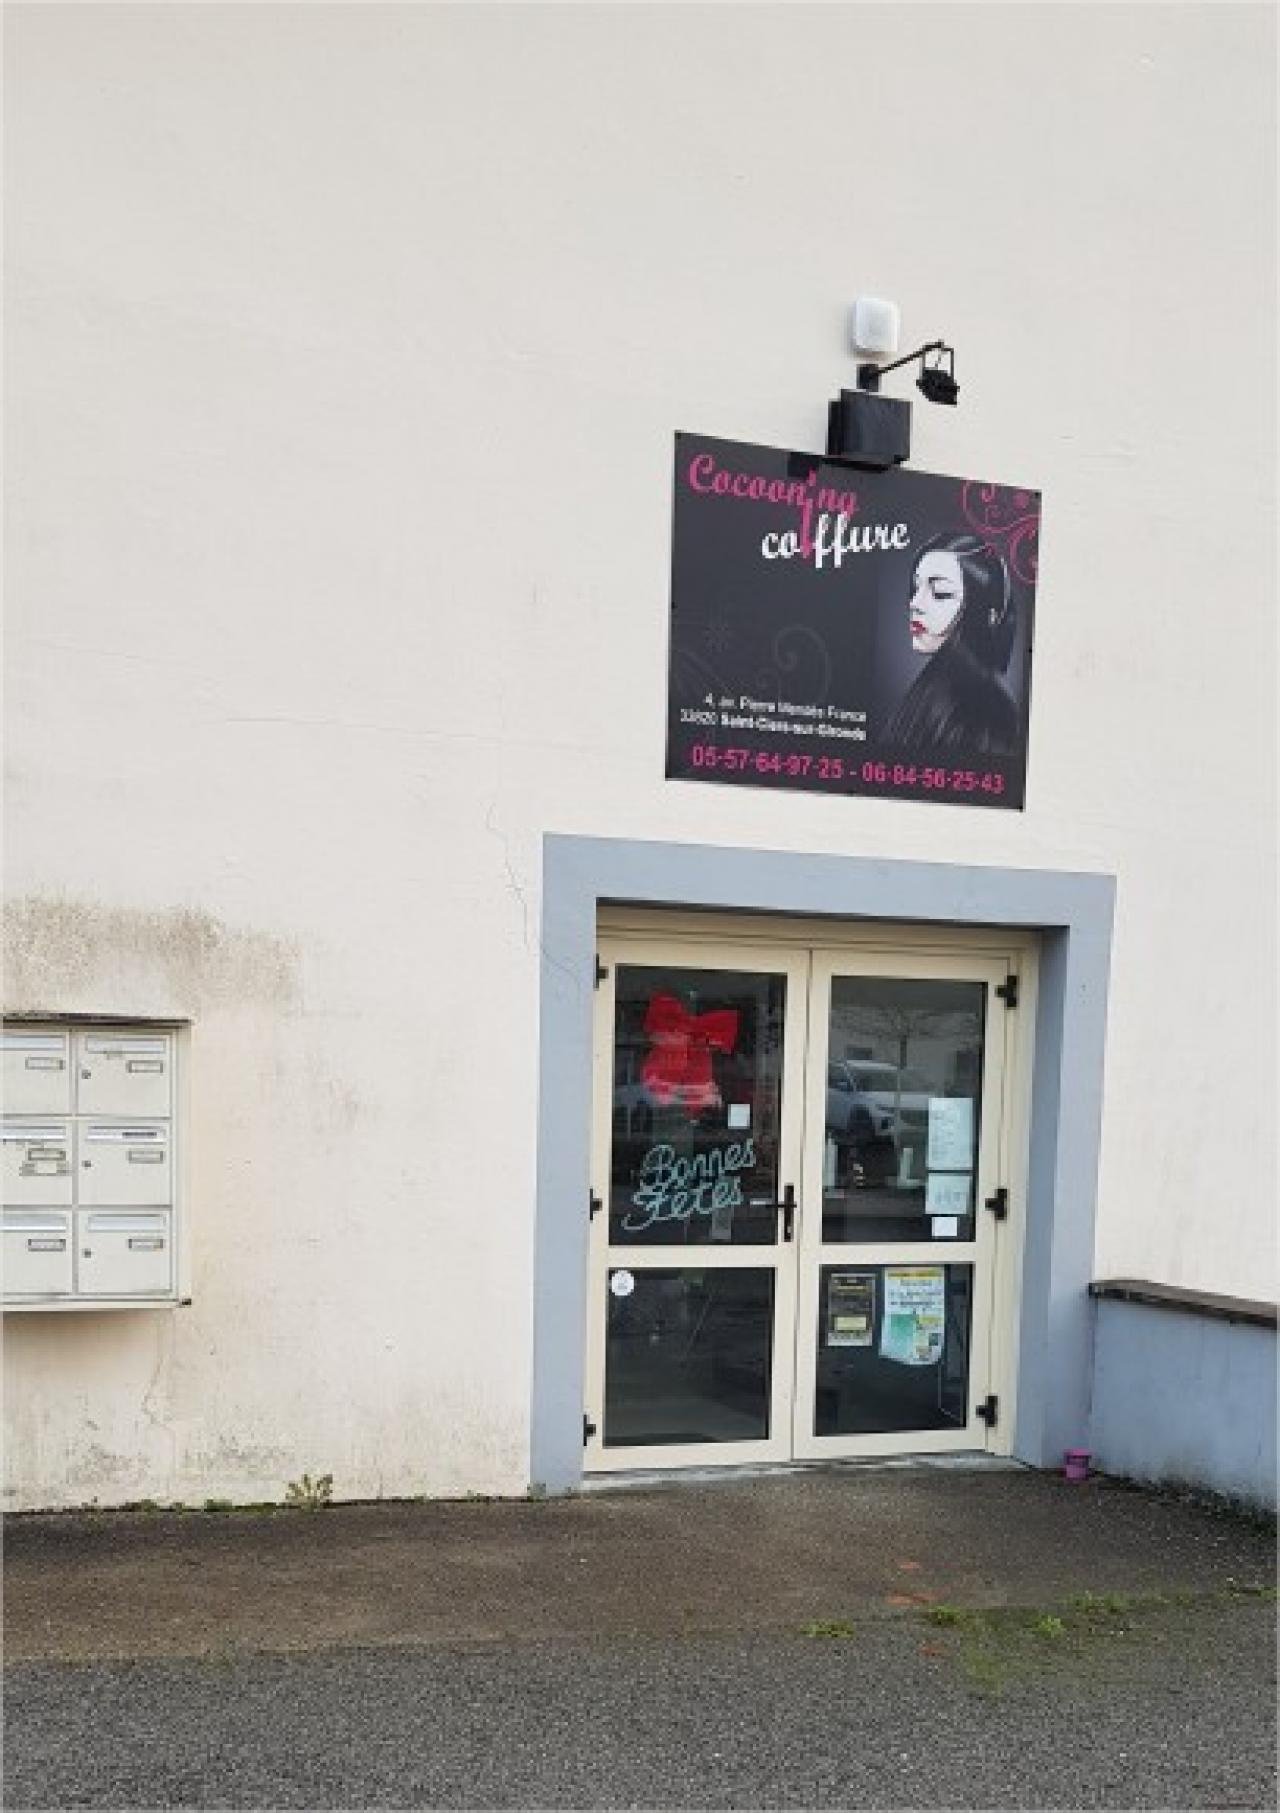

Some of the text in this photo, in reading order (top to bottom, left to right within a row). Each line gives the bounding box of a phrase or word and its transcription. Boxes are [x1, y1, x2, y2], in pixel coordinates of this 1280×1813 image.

[690, 454, 857, 522] Cocooning
[762, 513, 910, 568] coiffure
[640, 1138, 756, 1187] Bonnes
